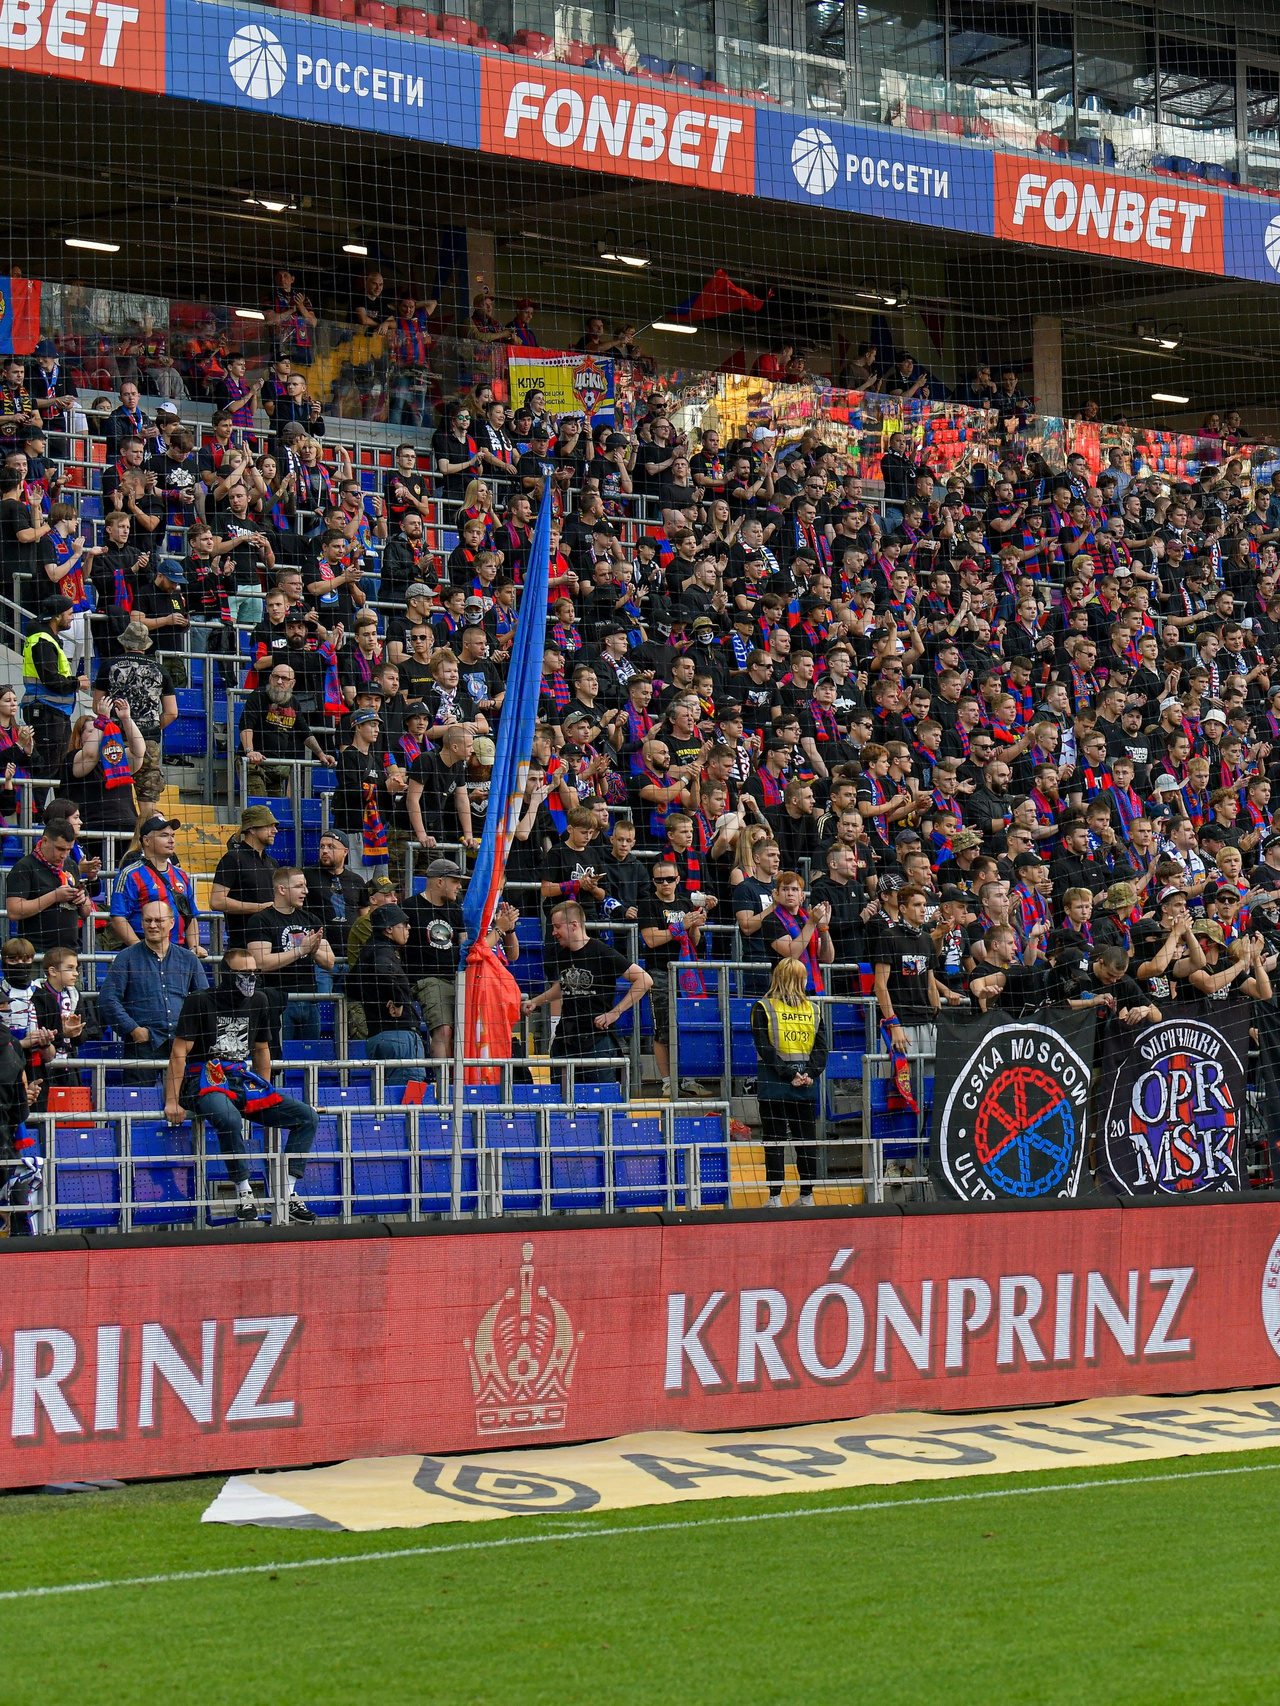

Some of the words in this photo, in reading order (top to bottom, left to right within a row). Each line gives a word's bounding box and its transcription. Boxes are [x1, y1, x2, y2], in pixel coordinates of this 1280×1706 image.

[297, 53, 424, 108] РОССЕТИ
[503, 81, 743, 174] FONBET
[846, 153, 948, 199] РОССЕТИ
[1012, 172, 1207, 254] FONBET
[517, 377, 545, 389] КЛУБ
[781, 1012, 813, 1022] SAFETY
[962, 1046, 1005, 1110] CSKA
[1011, 1037, 1088, 1107] MOSCOW
[1131, 1060, 1236, 1124] OPR
[1128, 1123, 1237, 1186] MSK
[663, 1248, 1194, 1389] KRÓNPRINZ
